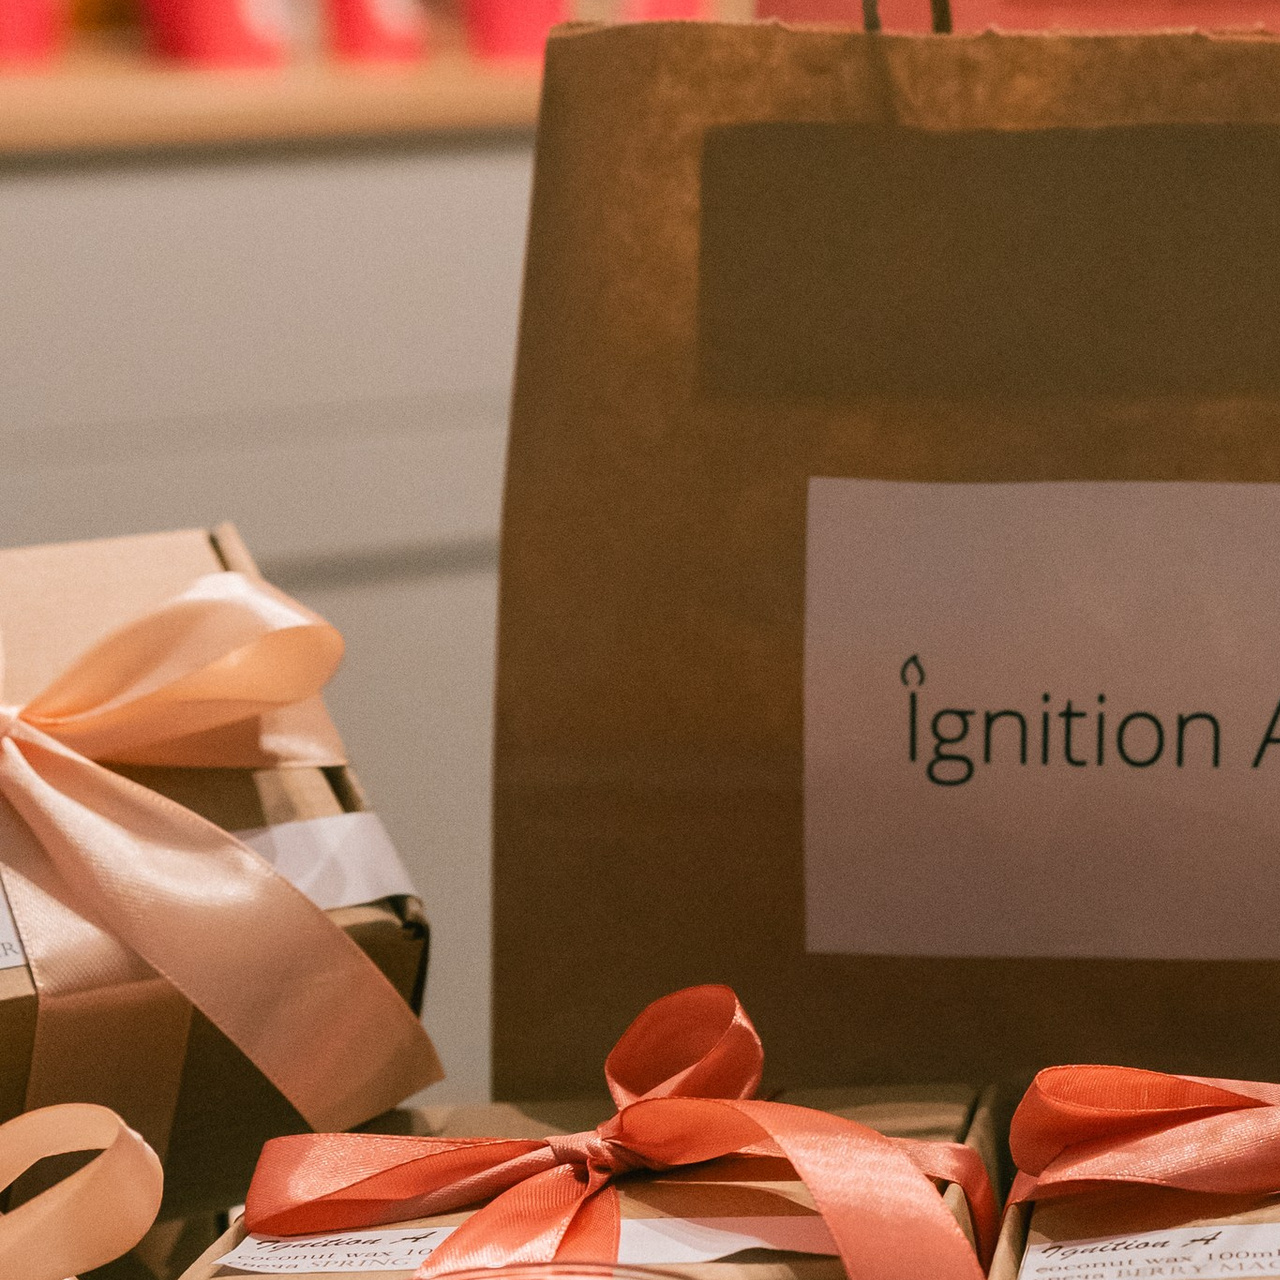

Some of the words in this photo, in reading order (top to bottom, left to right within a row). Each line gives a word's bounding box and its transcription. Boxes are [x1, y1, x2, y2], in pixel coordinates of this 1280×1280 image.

[901, 655, 1221, 786] Ignition
[256, 1237, 382, 1253] Ignition
[389, 1231, 438, 1245] A
[1041, 1239, 1171, 1261] Ignition
[1181, 1230, 1223, 1247] A
[237, 1253, 335, 1261] coconut
[310, 1258, 412, 1268] SPRING
[1035, 1259, 1134, 1274] coconut
[1145, 1255, 1193, 1265] wax
[1117, 1263, 1208, 1278] BERRY
